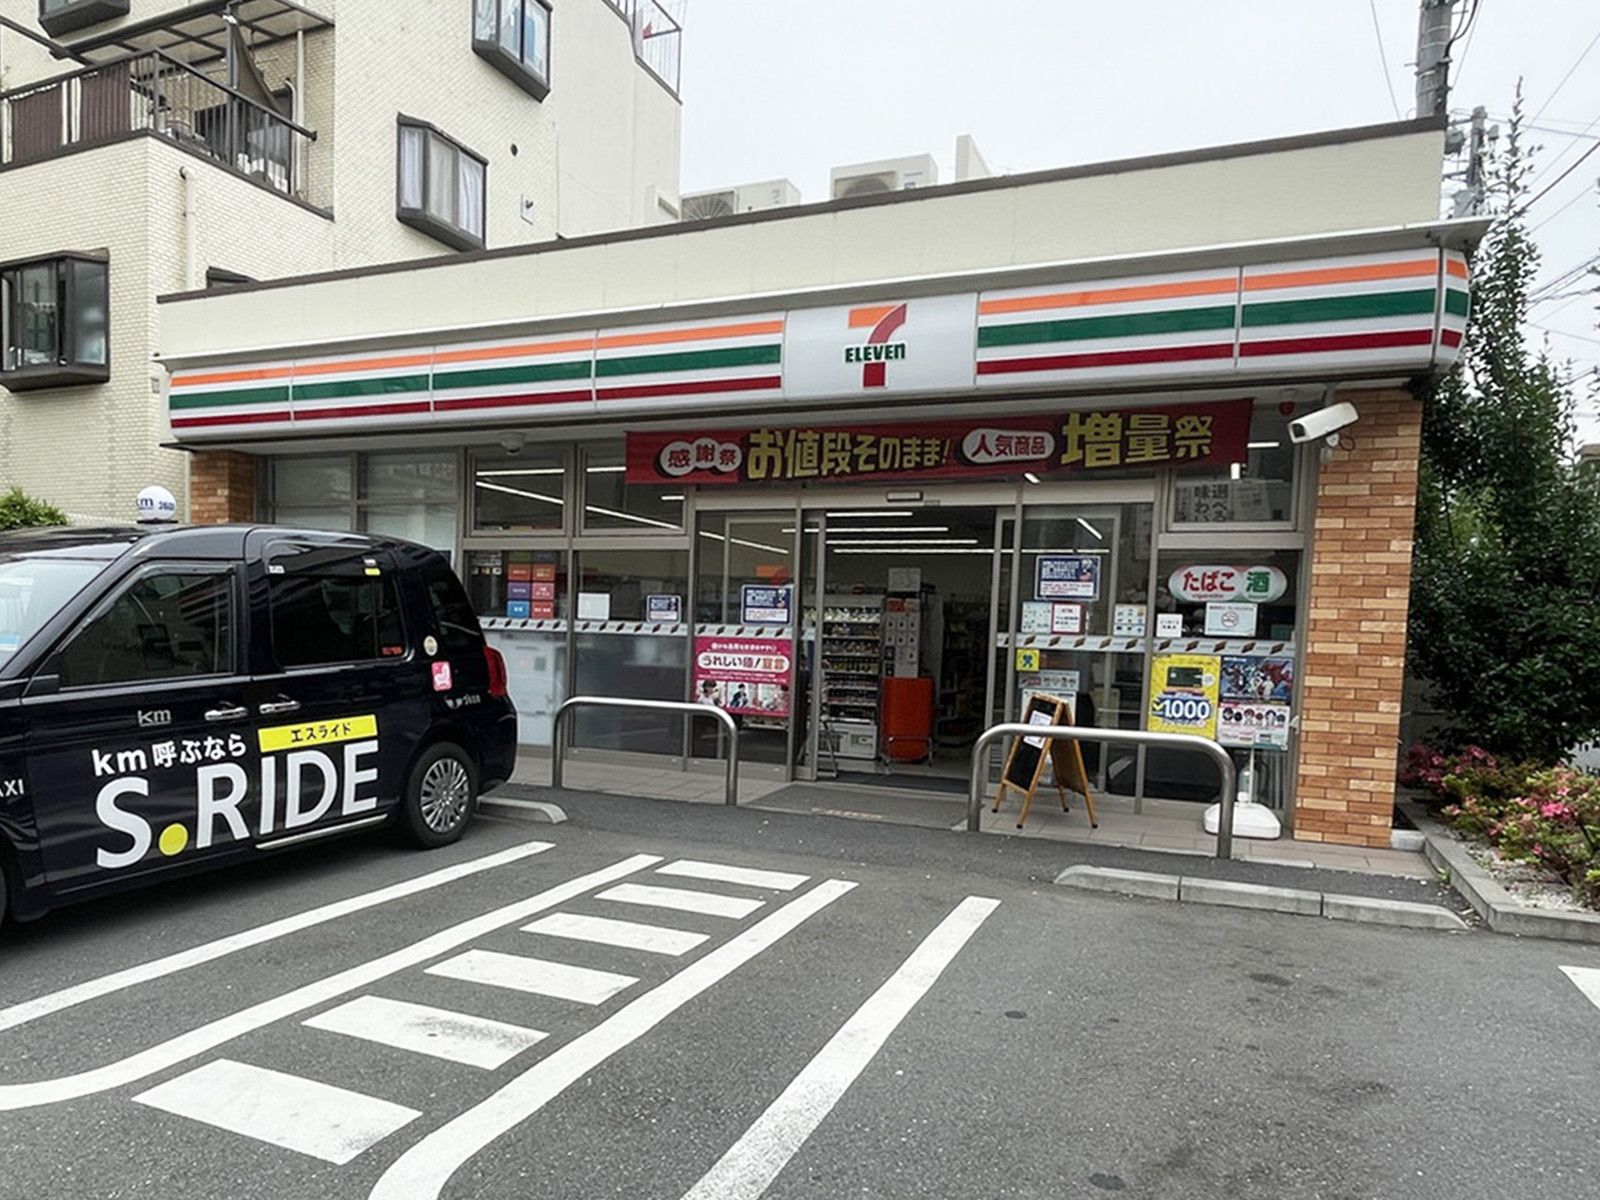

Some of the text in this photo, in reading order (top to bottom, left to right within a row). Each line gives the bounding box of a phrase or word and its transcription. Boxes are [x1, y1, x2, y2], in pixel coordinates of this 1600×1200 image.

[971, 433, 1046, 458] 人気商品
[1061, 412, 1213, 468] 増量祭
[667, 442, 737, 468] 感謝祭
[1183, 571, 1270, 593] たばこ 酒
[137, 709, 172, 727] km
[291, 722, 351, 742] エスライド
[92, 733, 247, 777] km 呼ぶなら
[0, 778, 25, 798] XI
